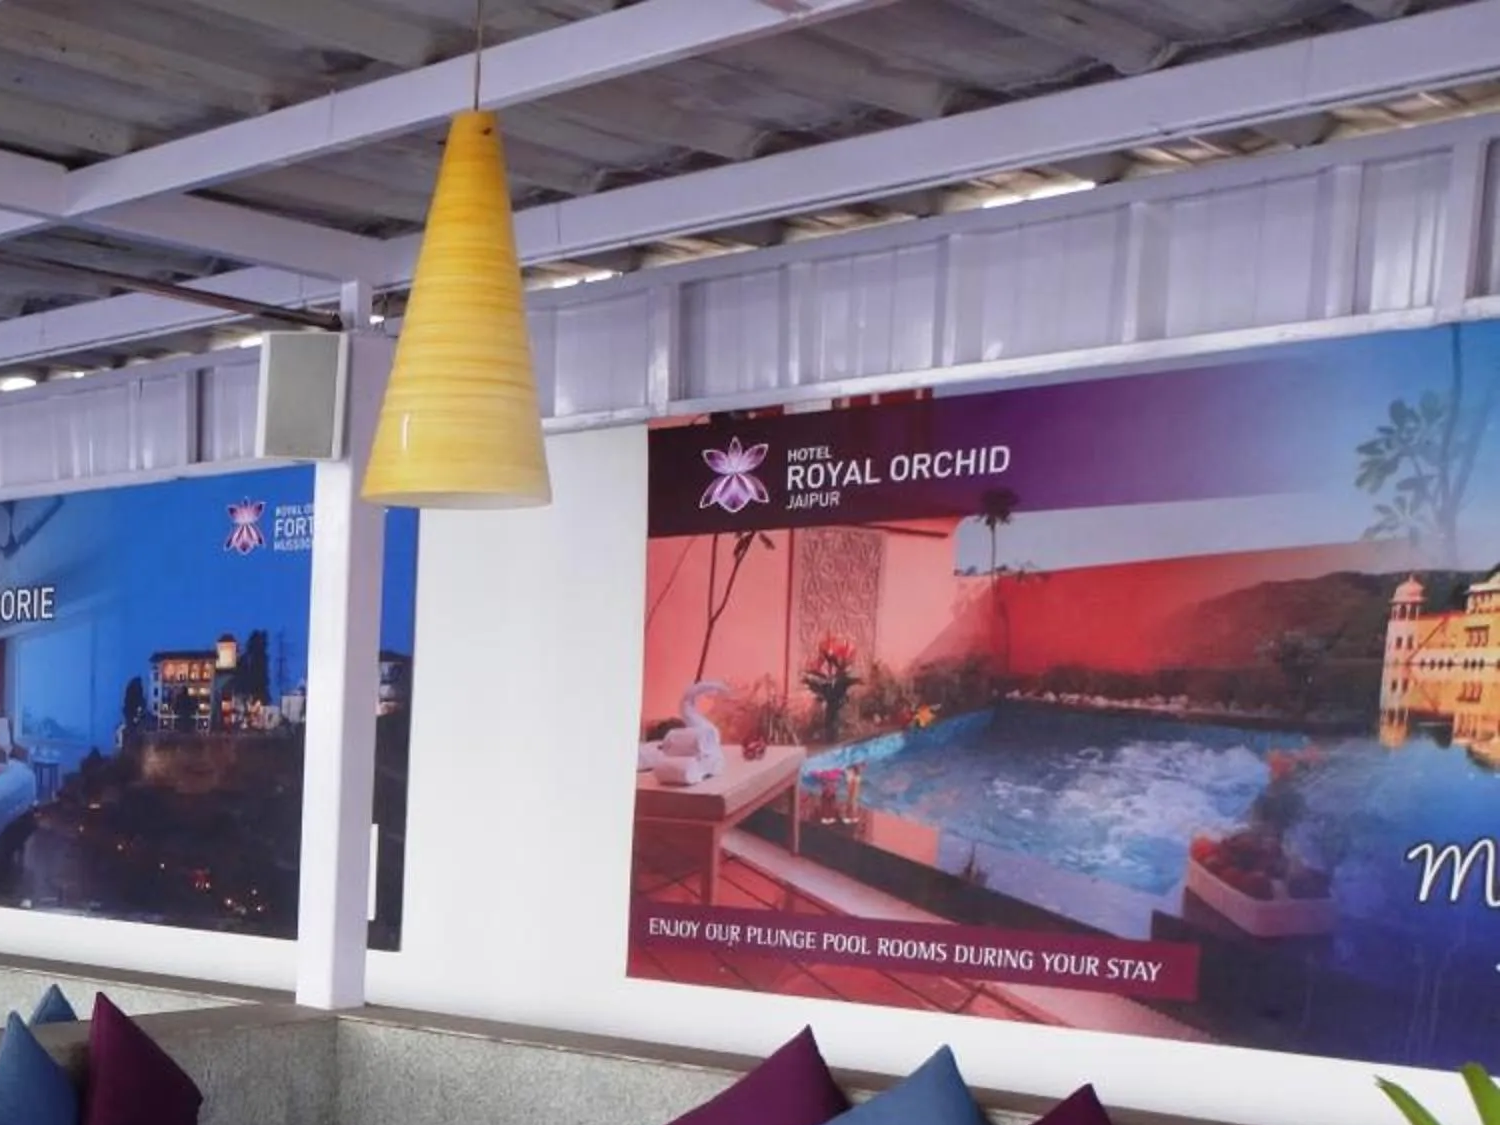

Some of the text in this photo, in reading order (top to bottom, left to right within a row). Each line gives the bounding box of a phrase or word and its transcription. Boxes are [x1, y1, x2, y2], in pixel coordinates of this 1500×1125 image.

[786, 446, 1011, 491] ROYAL ORCHID
[787, 446, 832, 462] HOTEL
[785, 491, 841, 510] JAIPUR
[649, 917, 1164, 982] ENJOY OUR PLUNGE POOL ROOMS DURING YOUR STAY
